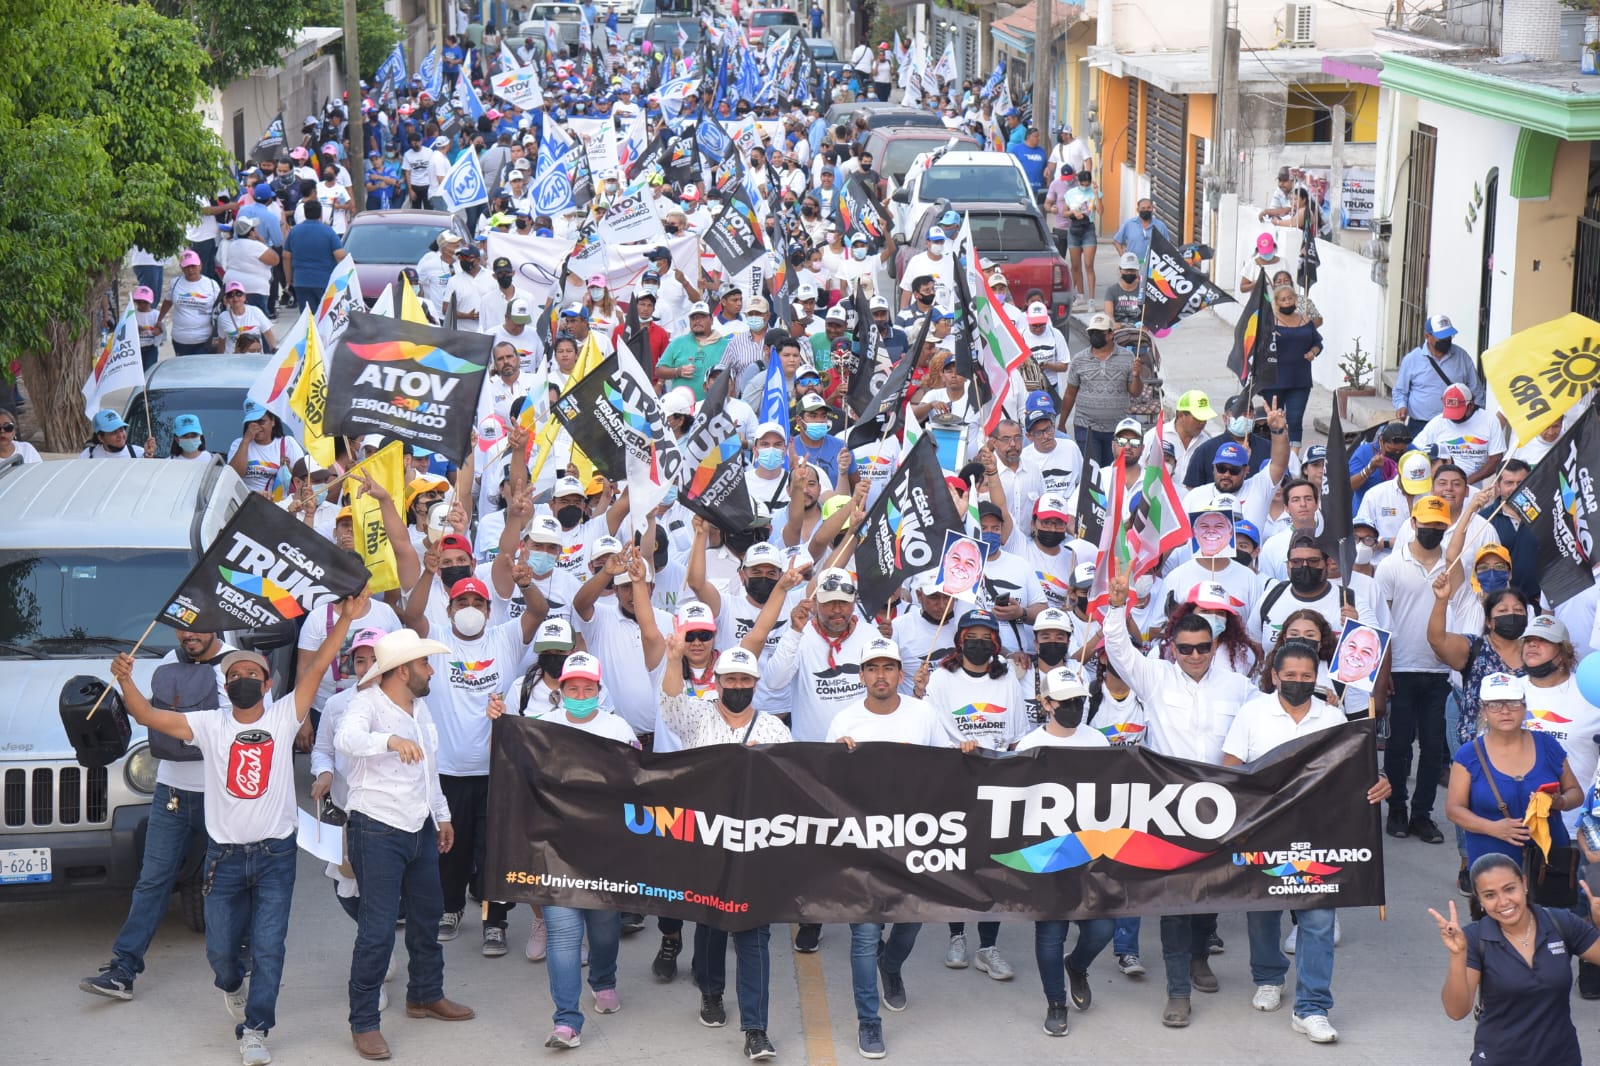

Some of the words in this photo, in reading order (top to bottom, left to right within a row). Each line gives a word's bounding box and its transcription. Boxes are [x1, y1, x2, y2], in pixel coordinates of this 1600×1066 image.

[1344, 201, 1374, 209] TRUKO
[725, 207, 756, 248] VOTA
[1147, 249, 1193, 295] RUKO
[595, 394, 626, 440] VERÁSTE
[911, 486, 935, 527] CÉSAR
[1578, 467, 1598, 514] CÉSAR
[367, 520, 379, 555] PRD
[277, 542, 325, 581] CÉSAR
[816, 678, 849, 687] TAMPS.
[816, 682, 868, 695] CONMADR
[2, 743, 34, 752] Jeep
[236, 746, 262, 796] Cash
[624, 803, 967, 852] UNIVERSITARIOS
[977, 782, 1237, 840] TRUKO
[906, 847, 966, 874] CON
[1232, 848, 1372, 867] UNIVERSITARIO
[1290, 842, 1311, 850] SER
[506, 871, 749, 913] #SerUniversitarioTampsConMadre
[1281, 875, 1324, 885] TAMPS.
